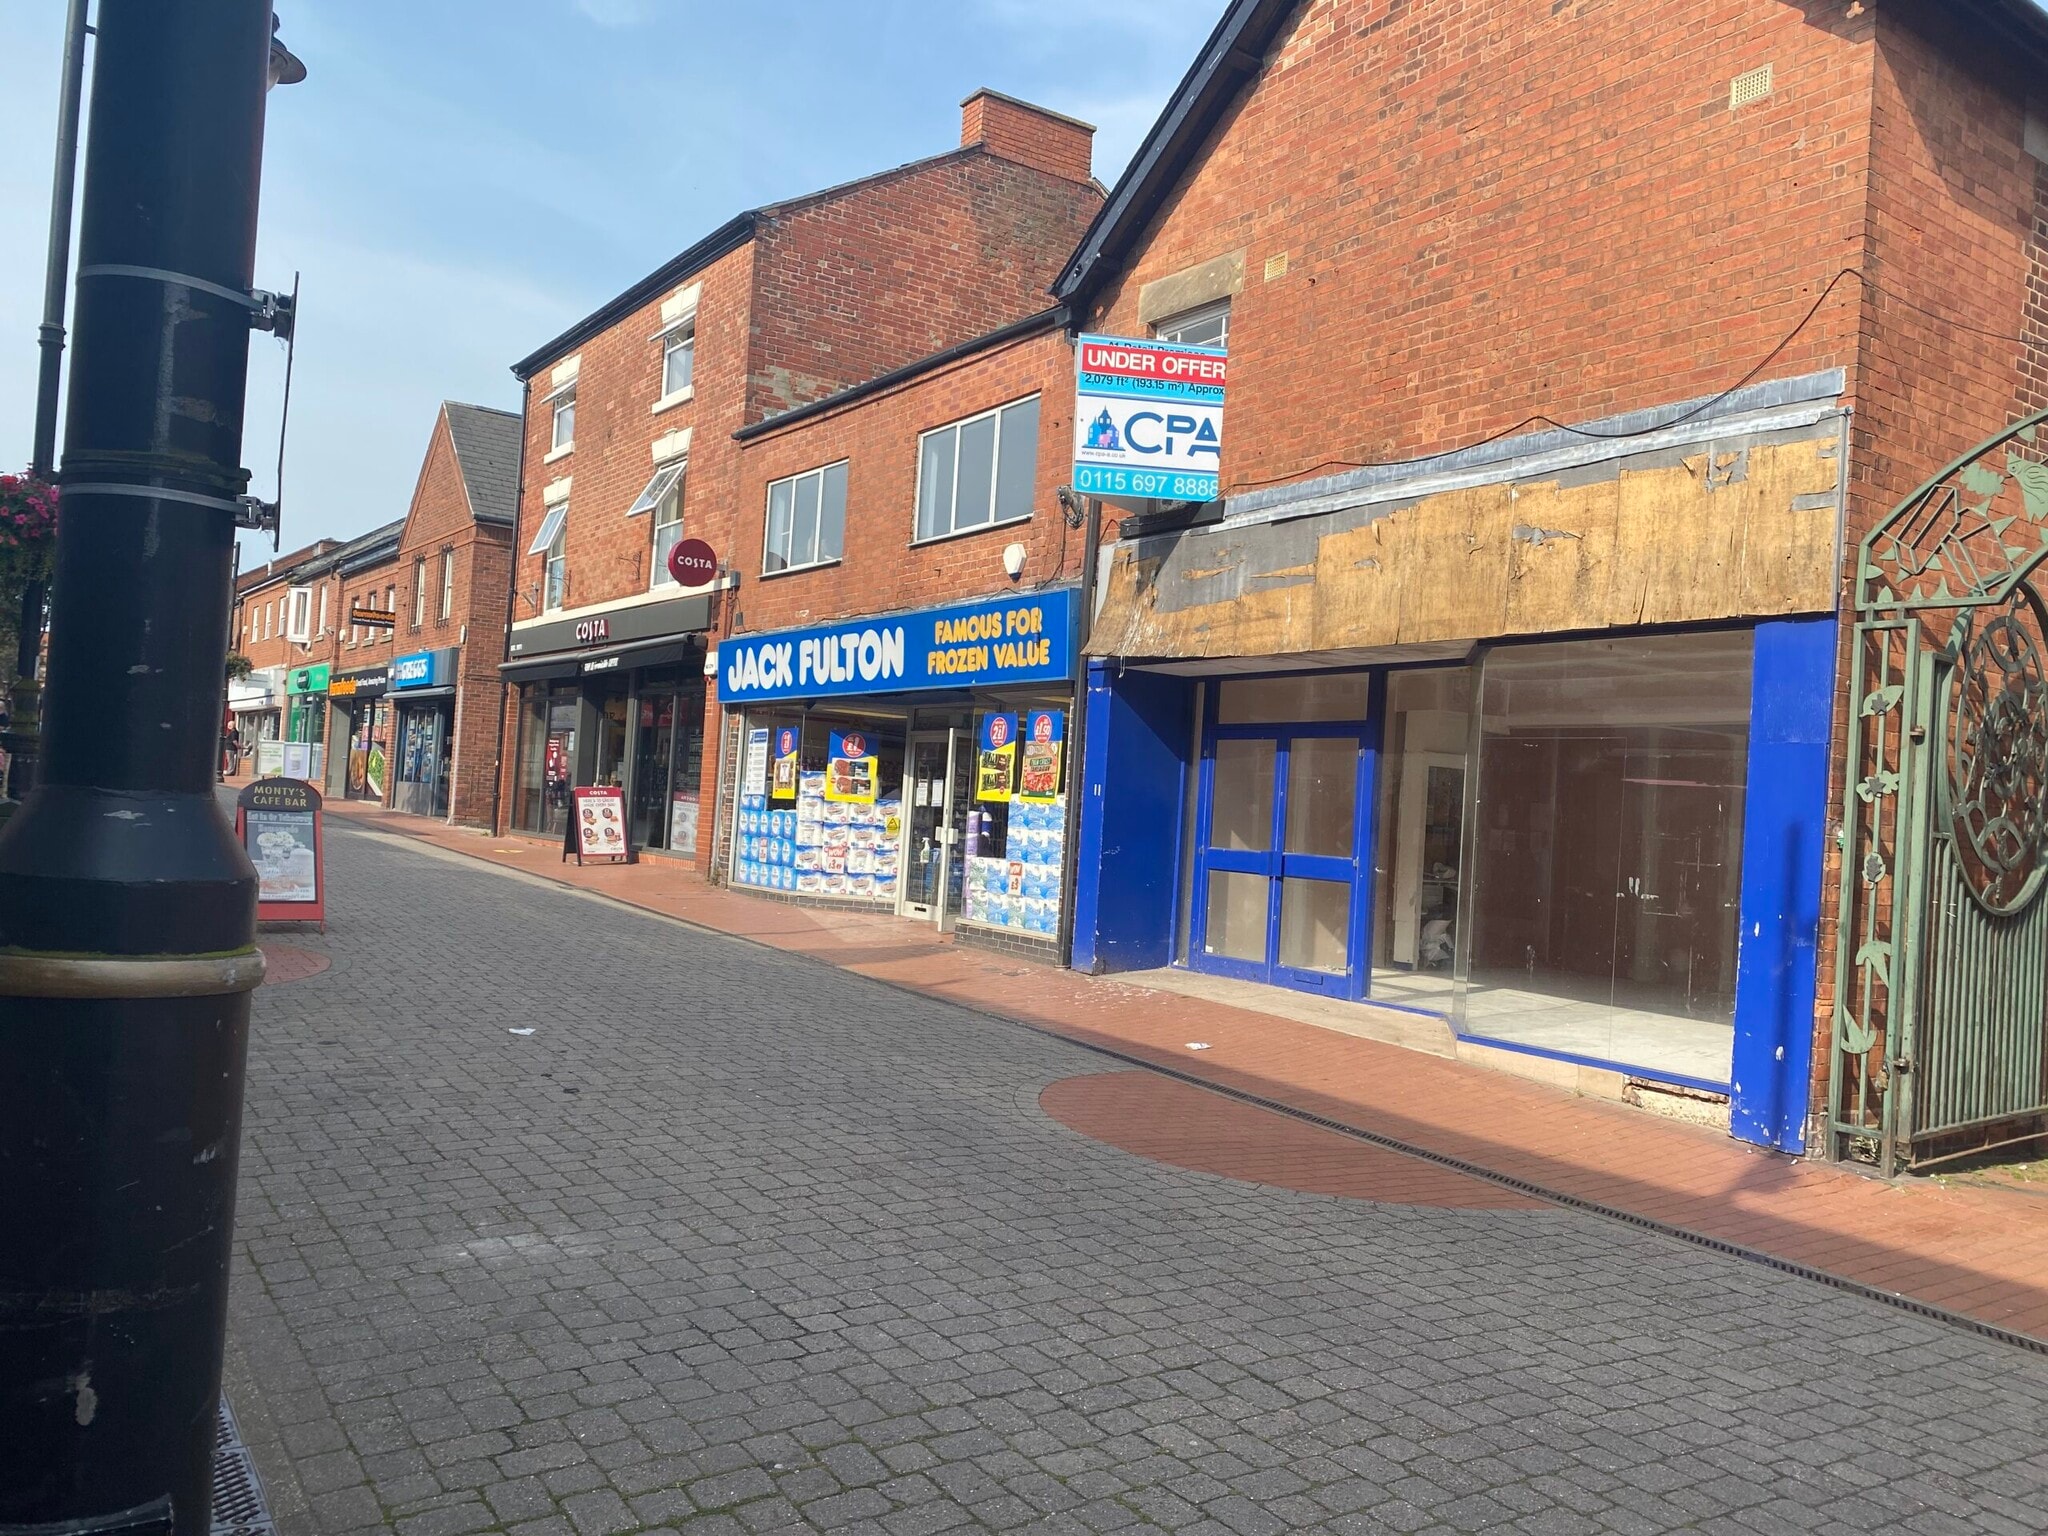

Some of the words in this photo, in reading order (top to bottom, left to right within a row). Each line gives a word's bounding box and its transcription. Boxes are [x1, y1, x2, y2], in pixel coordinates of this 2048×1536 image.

[1087, 349, 1155, 372] UNDER
[1162, 357, 1226, 379] OFFER
[1085, 373, 1113, 386] 2,079
[1132, 378, 1165, 390] (193.15
[1124, 411, 1221, 459] CPA
[1080, 469, 1126, 490] 0115
[1132, 474, 1167, 493] 697
[1173, 477, 1218, 496] 8888
[677, 555, 712, 569] COSTA
[575, 619, 606, 640] COSTA
[935, 612, 1002, 645] FAMOUS
[1006, 606, 1042, 635] FOR
[728, 641, 792, 693] JACK
[799, 626, 904, 686] FULTON
[927, 645, 989, 676] FROZEN
[993, 638, 1050, 668] VALUE
[253, 796, 281, 805] CAFE
[284, 797, 307, 807] BAR
[254, 786, 306, 797] MONTY'S
